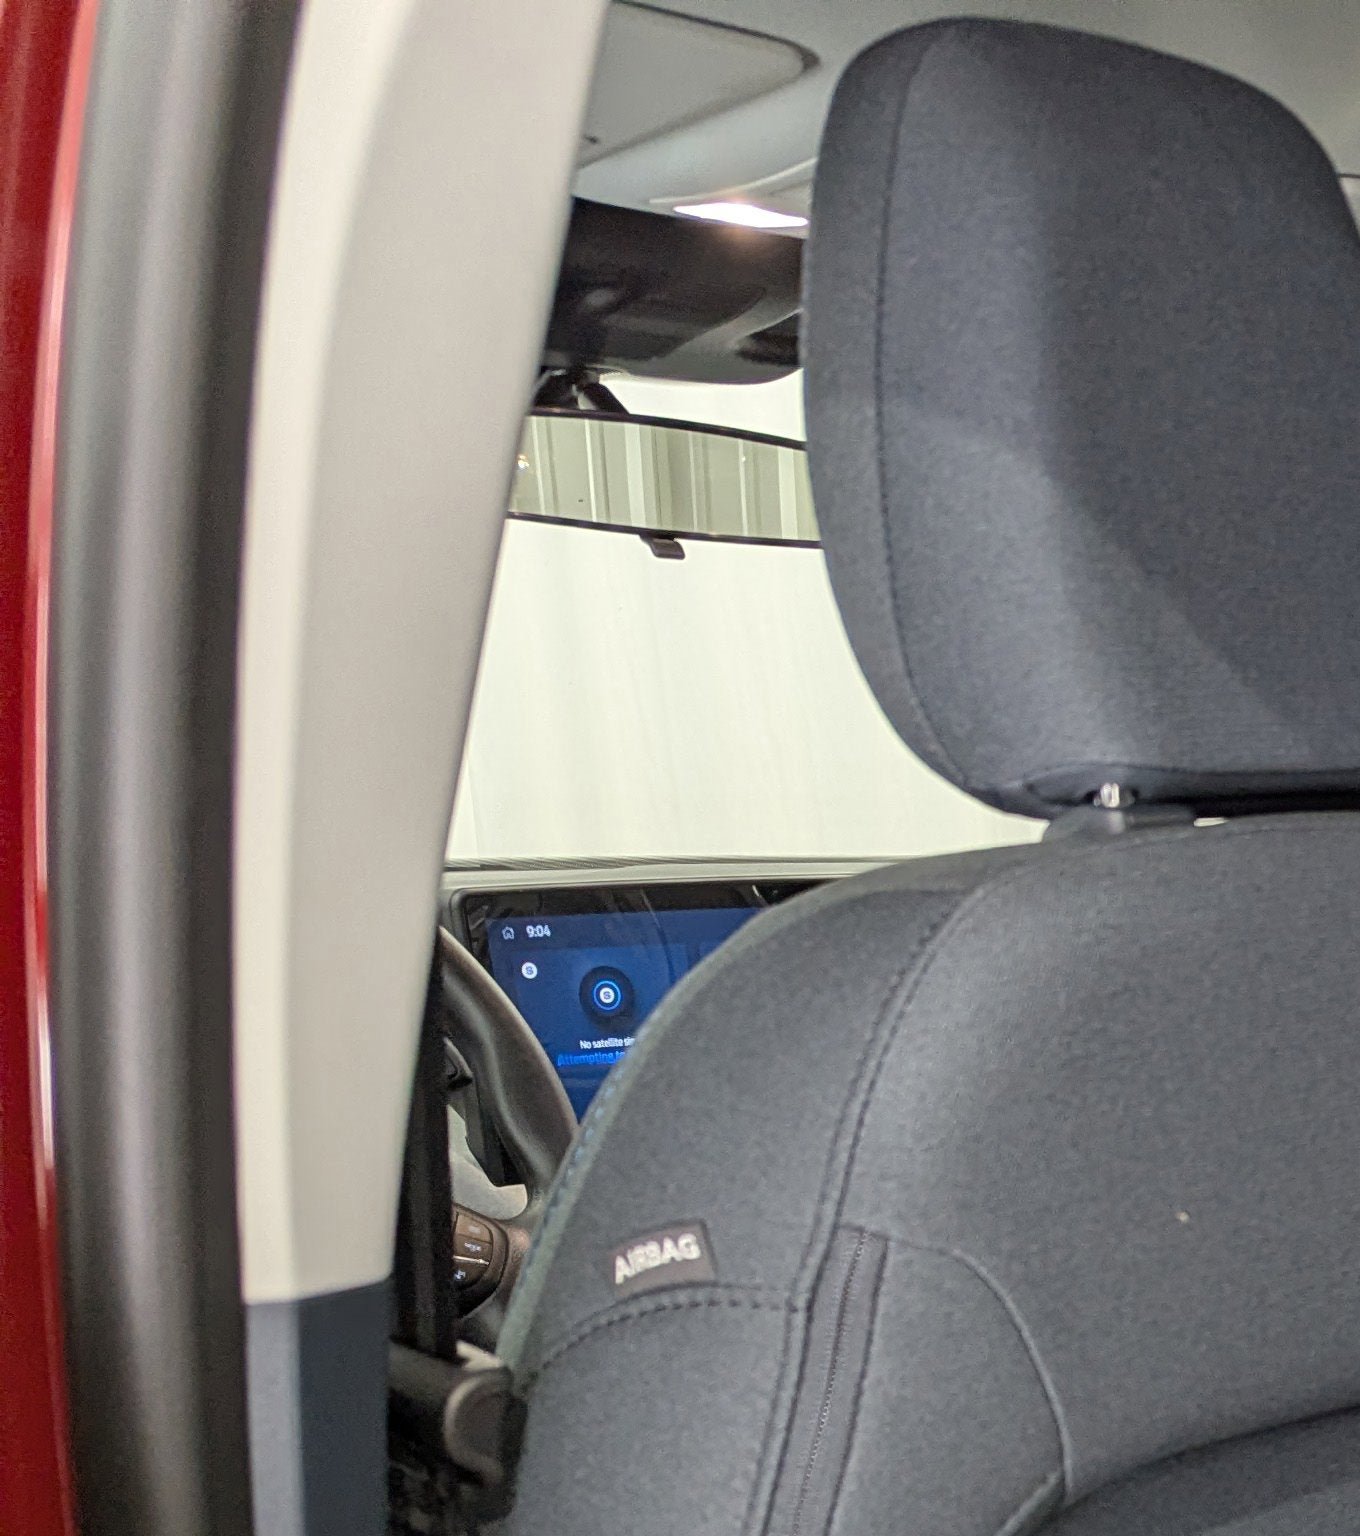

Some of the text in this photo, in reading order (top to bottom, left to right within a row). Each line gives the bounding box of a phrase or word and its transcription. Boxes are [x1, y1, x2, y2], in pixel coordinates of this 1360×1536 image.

[526, 924, 551, 938] 9:04
[579, 1039, 592, 1050] No
[593, 1038, 624, 1049] satellite
[557, 1051, 616, 1066] Attempting
[615, 1232, 701, 1285] AIRBAG
